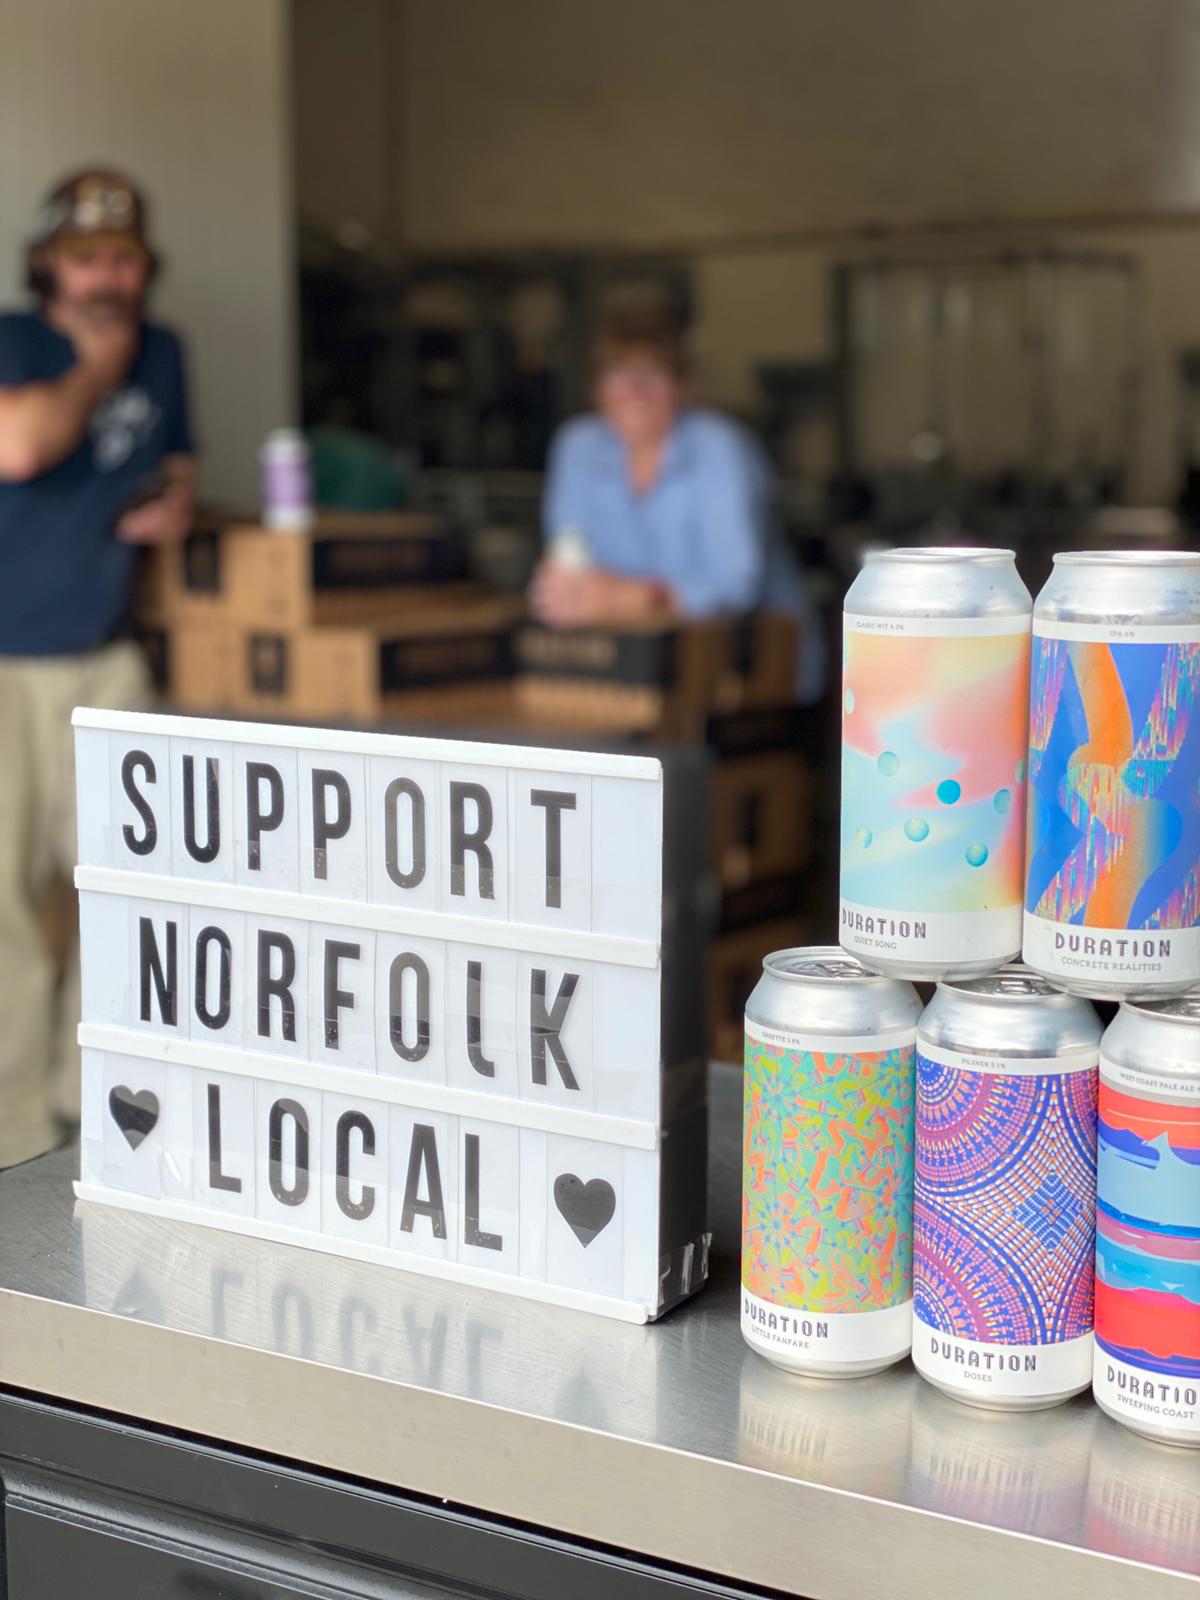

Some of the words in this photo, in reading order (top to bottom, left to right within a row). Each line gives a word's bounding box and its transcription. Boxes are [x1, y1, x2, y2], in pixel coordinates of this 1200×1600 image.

[121, 749, 577, 909] SUPPORT
[842, 908, 926, 939] DURATION
[854, 935, 873, 946] QUIET
[875, 940, 897, 949] SONG
[1055, 932, 1171, 957] DURATION
[1061, 956, 1109, 970] CONCRETE
[1112, 962, 1161, 971] REALITIES
[139, 916, 580, 1091] NORFOLK
[1136, 1077, 1158, 1087] COAST
[207, 1083, 503, 1252] LOCAL
[745, 1297, 828, 1338] DURATION
[751, 1323, 771, 1339] LITTLE
[772, 1334, 810, 1349] FANFARE
[931, 1337, 1037, 1372] DURATION
[964, 1370, 993, 1383] DOSES
[1107, 1365, 1197, 1406] DURATIO
[1117, 1393, 1160, 1413] SWEEPING
[1162, 1407, 1195, 1419] COAST
